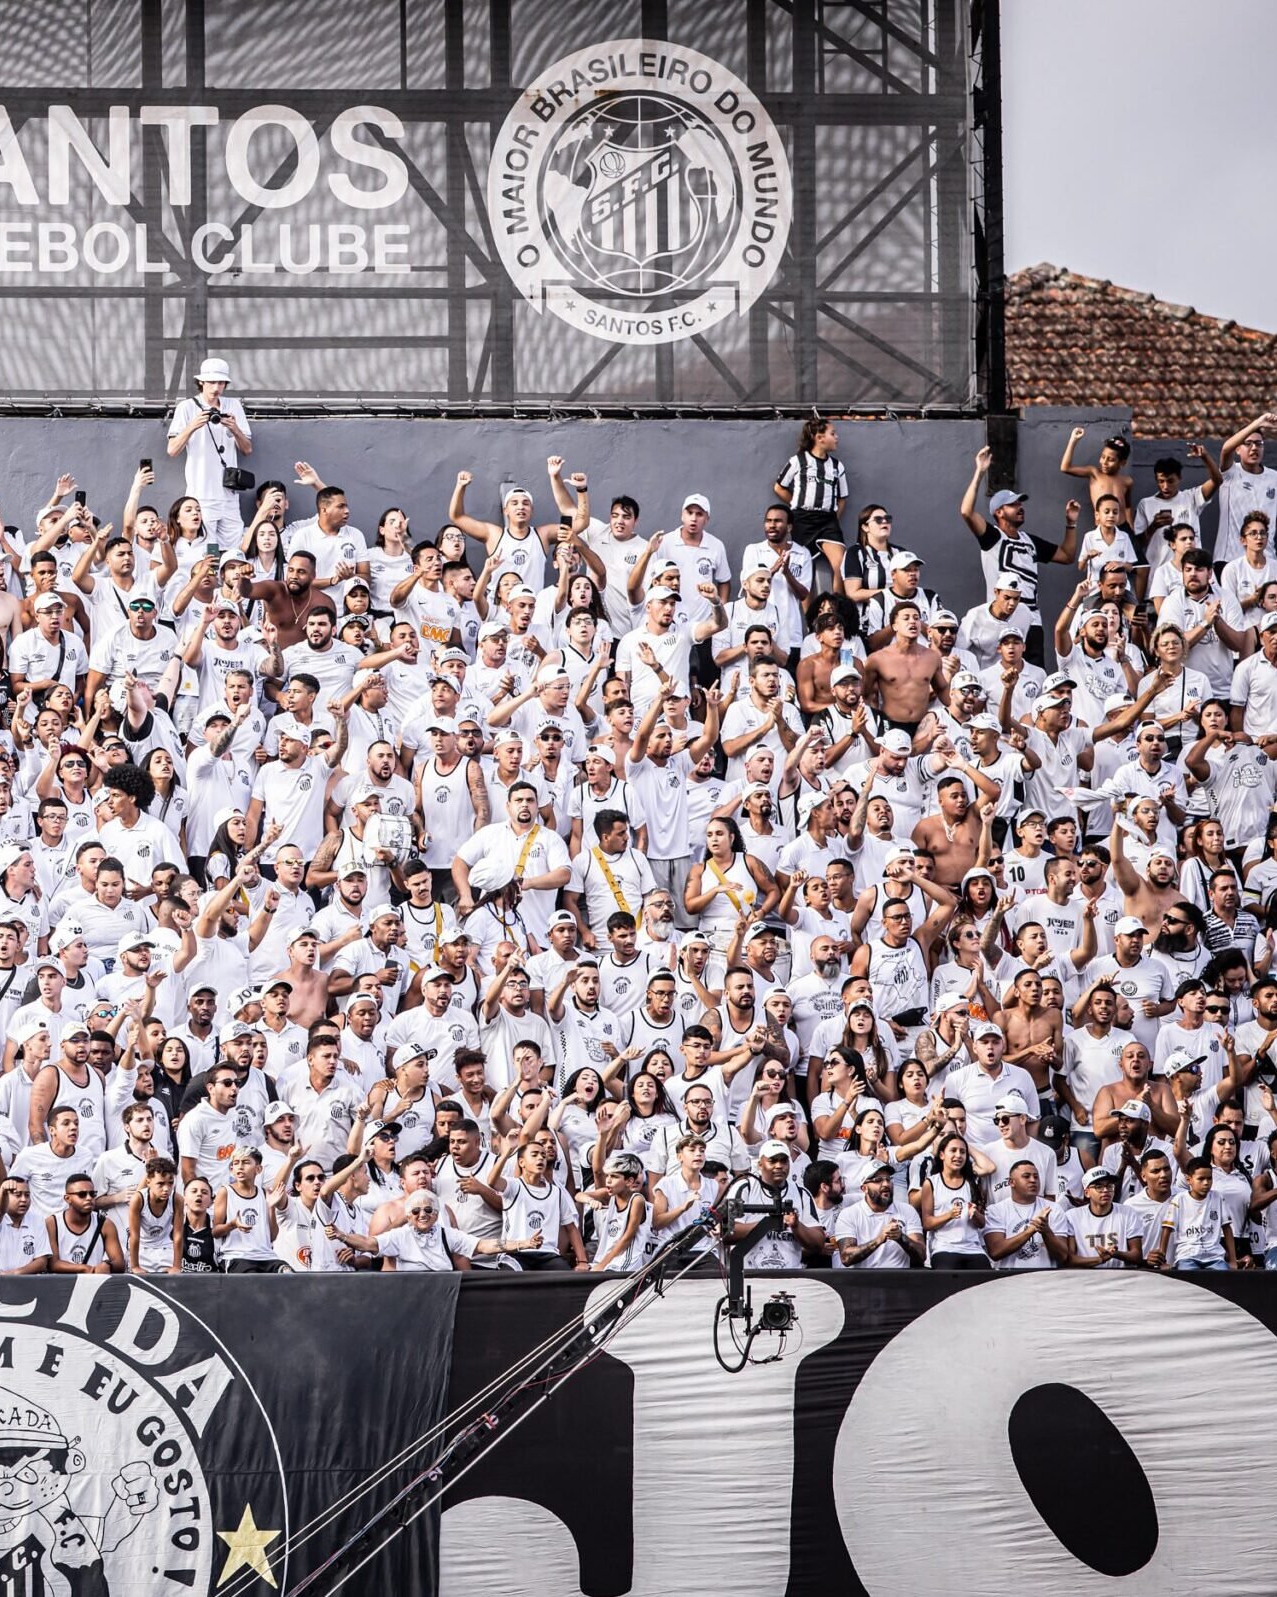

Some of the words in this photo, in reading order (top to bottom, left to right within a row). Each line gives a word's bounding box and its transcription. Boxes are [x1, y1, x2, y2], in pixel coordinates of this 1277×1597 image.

[530, 53, 712, 122] BRASILEIRO
[714, 90, 756, 134] DO
[502, 124, 540, 235] MAIOR
[742, 141, 778, 268] MUNDO
[191, 222, 412, 274] CLUBE
[517, 244, 540, 268] O
[583, 310, 664, 335] SANTOS
[668, 310, 703, 333] F.C.
[1008, 866, 1026, 882] 10
[36, 1343, 64, 1378] E
[81, 1361, 140, 1414] EU
[137, 1416, 202, 1549] GOSTO
